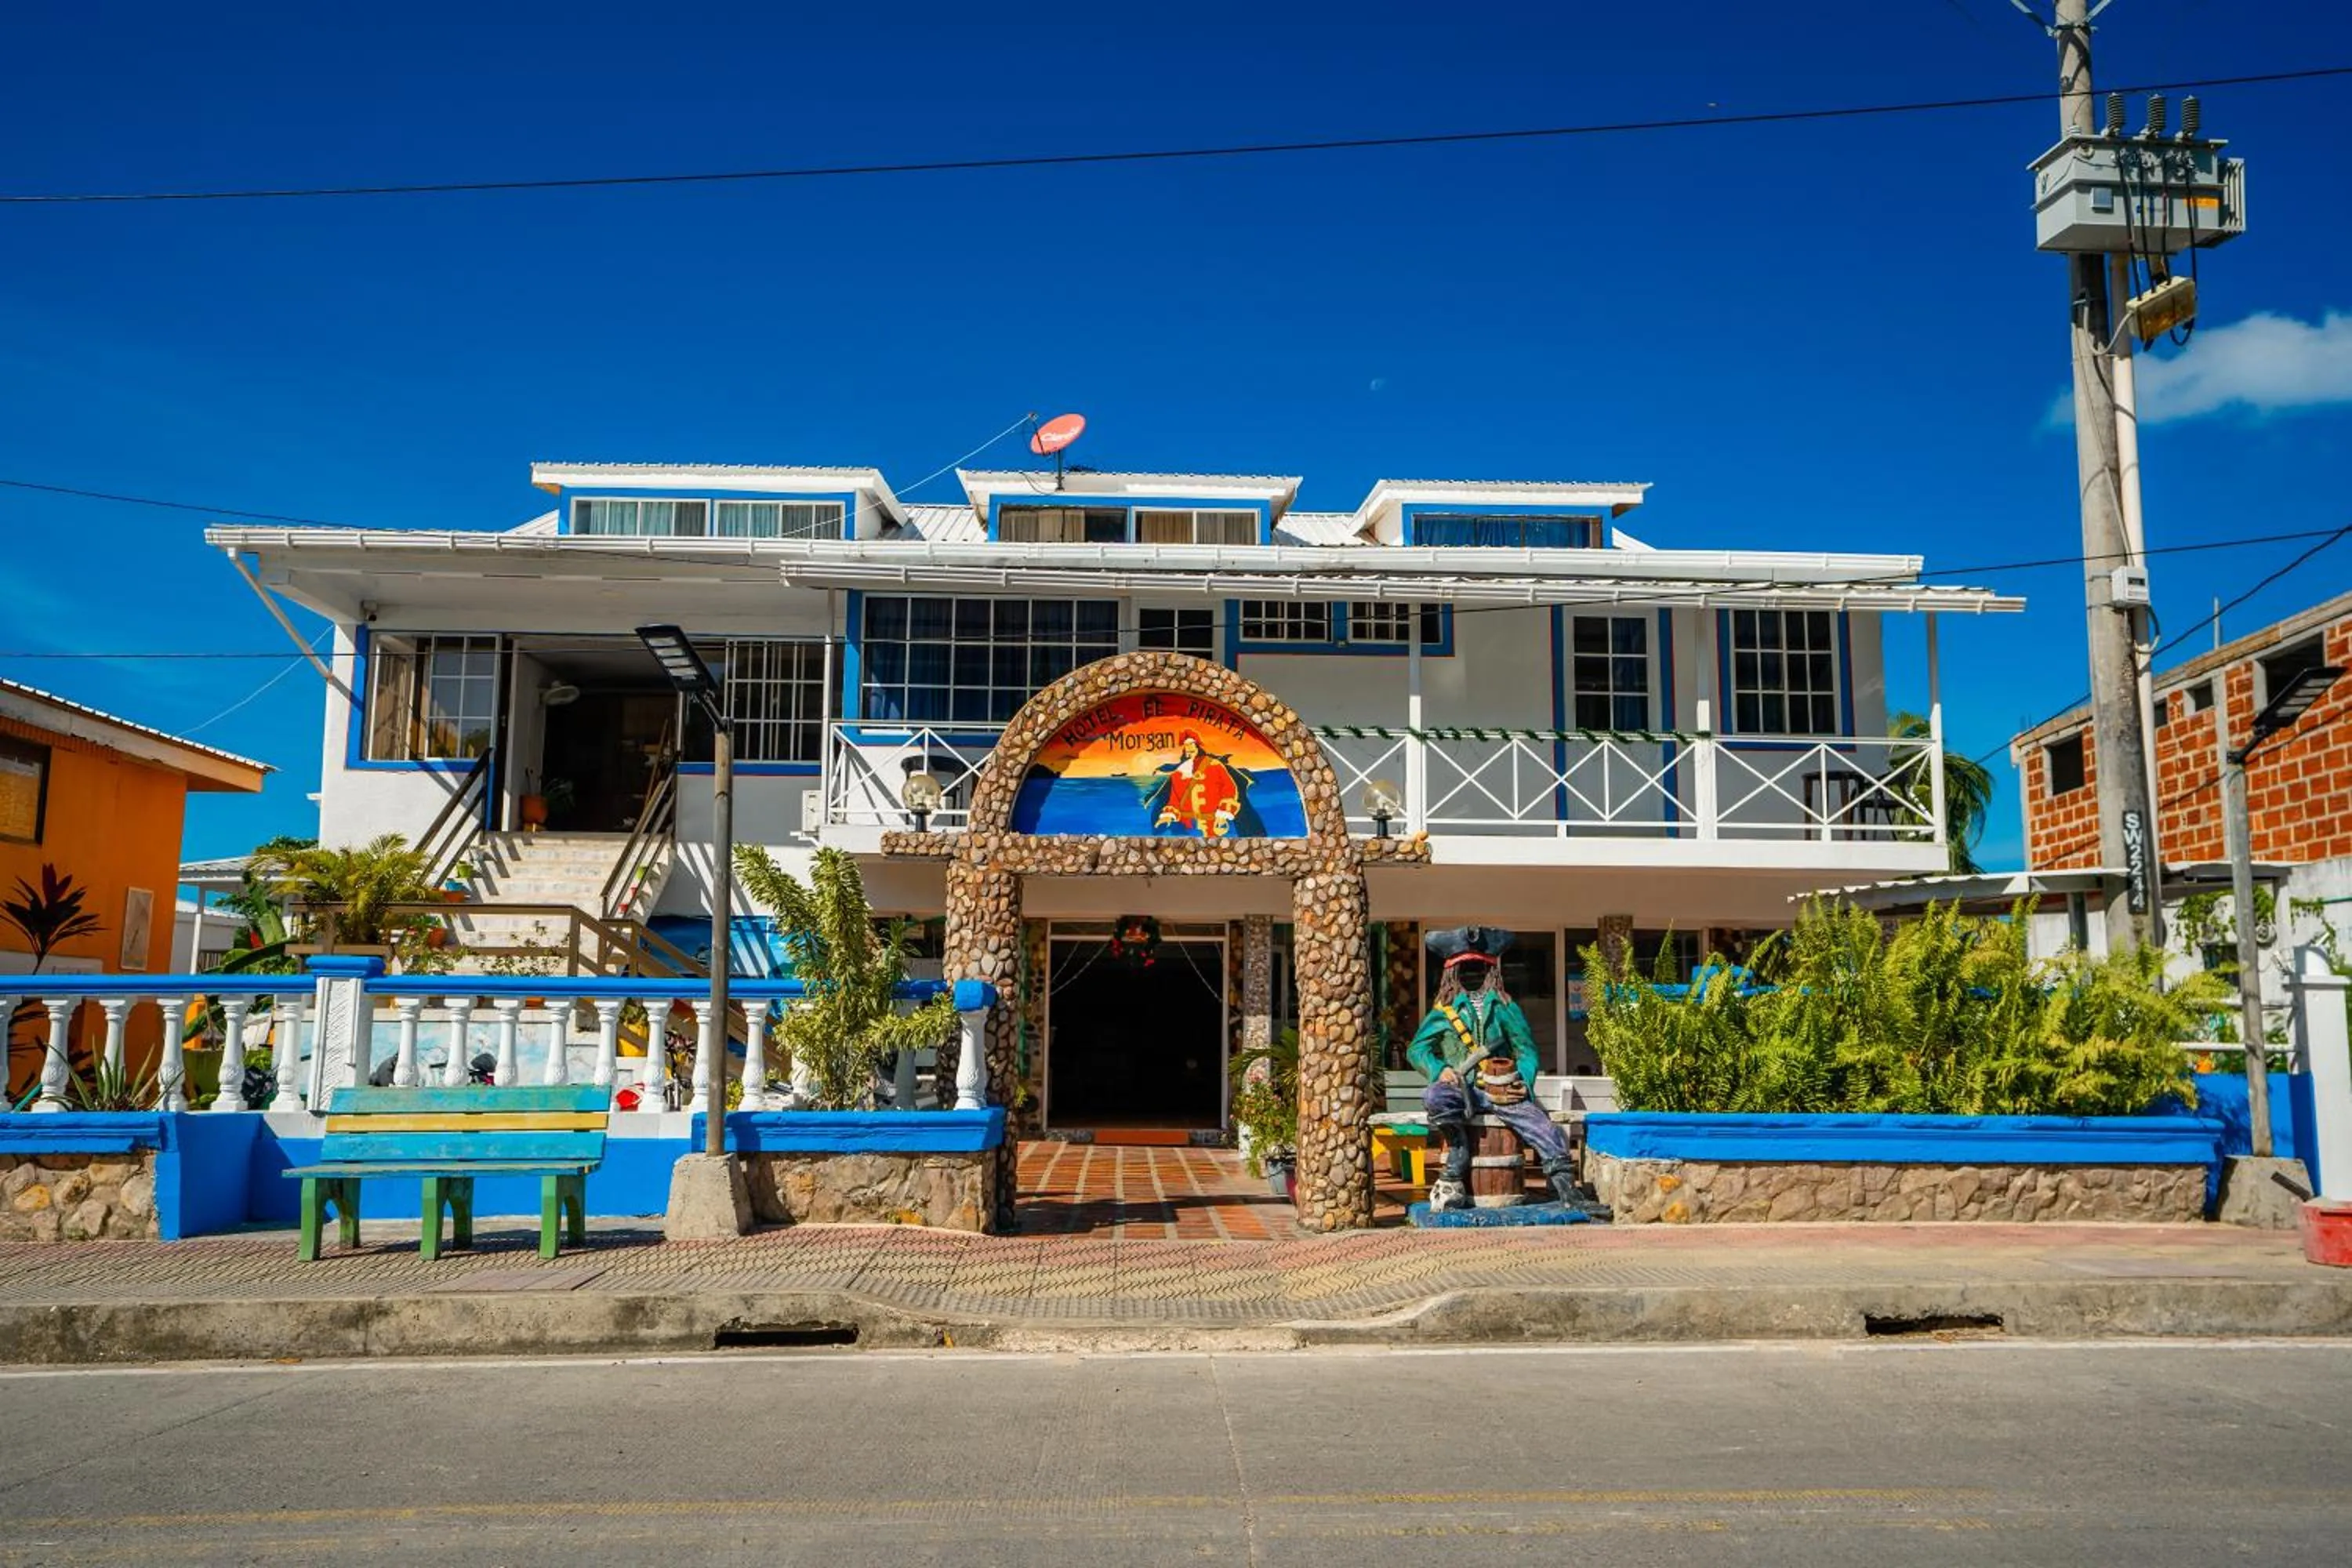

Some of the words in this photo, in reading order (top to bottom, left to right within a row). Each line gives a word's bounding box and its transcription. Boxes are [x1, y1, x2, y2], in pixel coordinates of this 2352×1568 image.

[1062, 706, 1116, 746] HOTEL
[1188, 702, 1247, 740] PIRATA
[1106, 731, 1176, 752] Morgan
